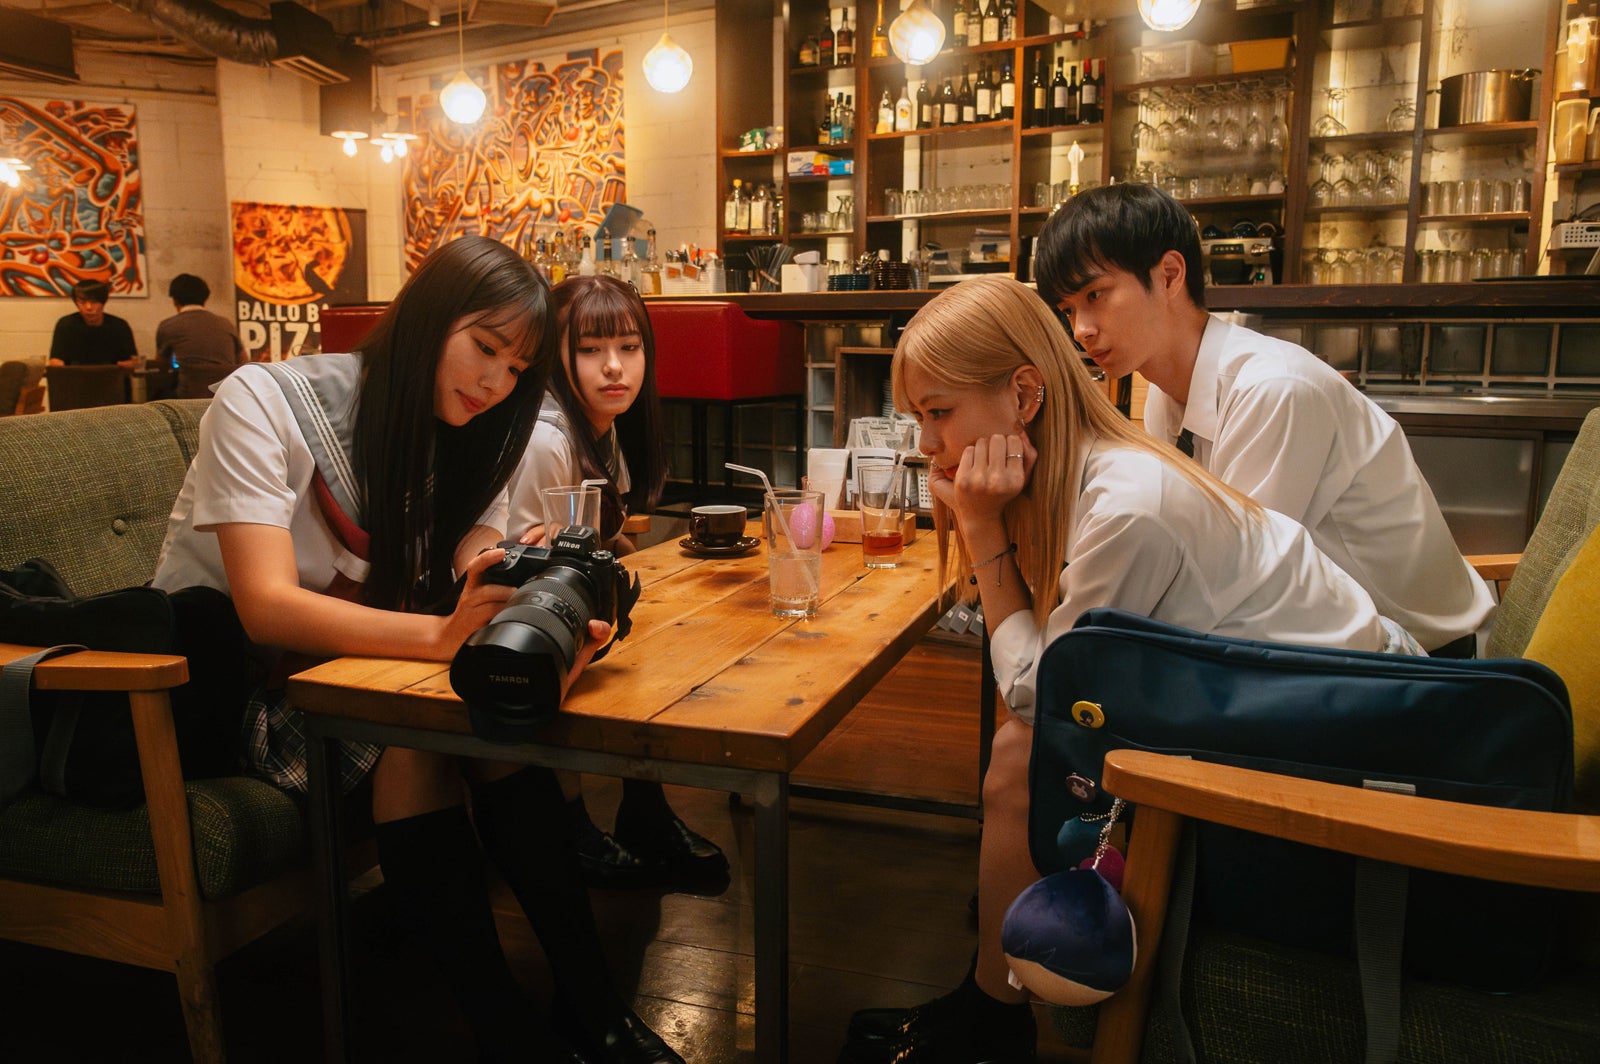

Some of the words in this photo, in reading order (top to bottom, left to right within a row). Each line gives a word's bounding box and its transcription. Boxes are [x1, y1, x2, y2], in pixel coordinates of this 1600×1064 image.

[238, 301, 300, 321] BALLO
[307, 303, 329, 322] B
[557, 540, 581, 550] Nikon
[488, 675, 529, 684] TAMRON
